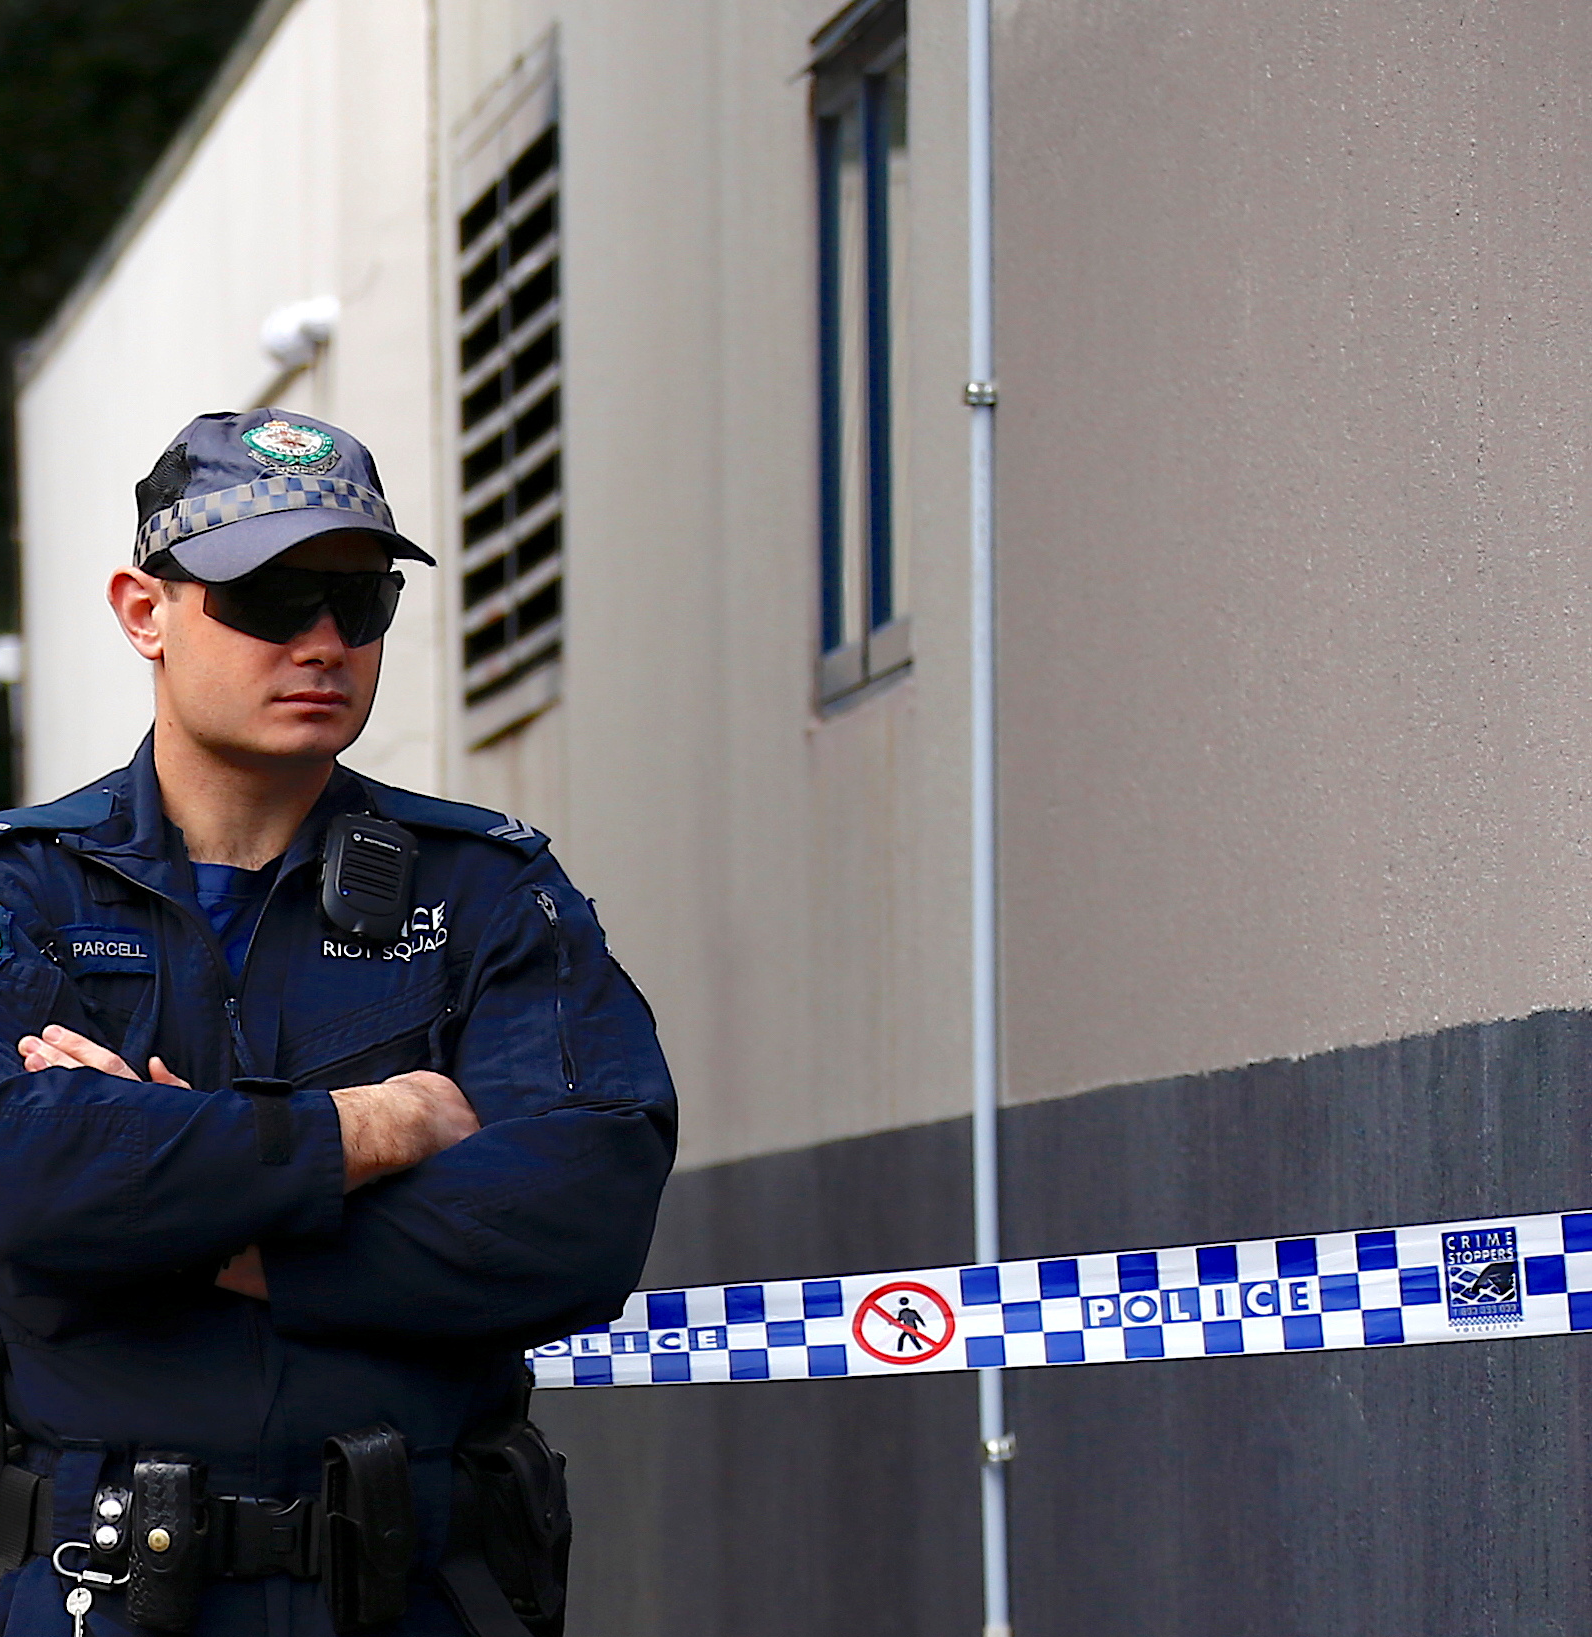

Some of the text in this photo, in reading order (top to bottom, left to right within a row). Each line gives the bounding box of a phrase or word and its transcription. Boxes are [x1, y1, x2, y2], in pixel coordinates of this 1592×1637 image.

[72, 941, 148, 958] PARCELL
[382, 927, 448, 962] SQUAD
[1445, 1230, 1514, 1251] CRIME
[1447, 1246, 1515, 1265] STOPPERS
[1087, 1281, 1310, 1327] POLICE
[534, 1329, 719, 1357] OLICE
